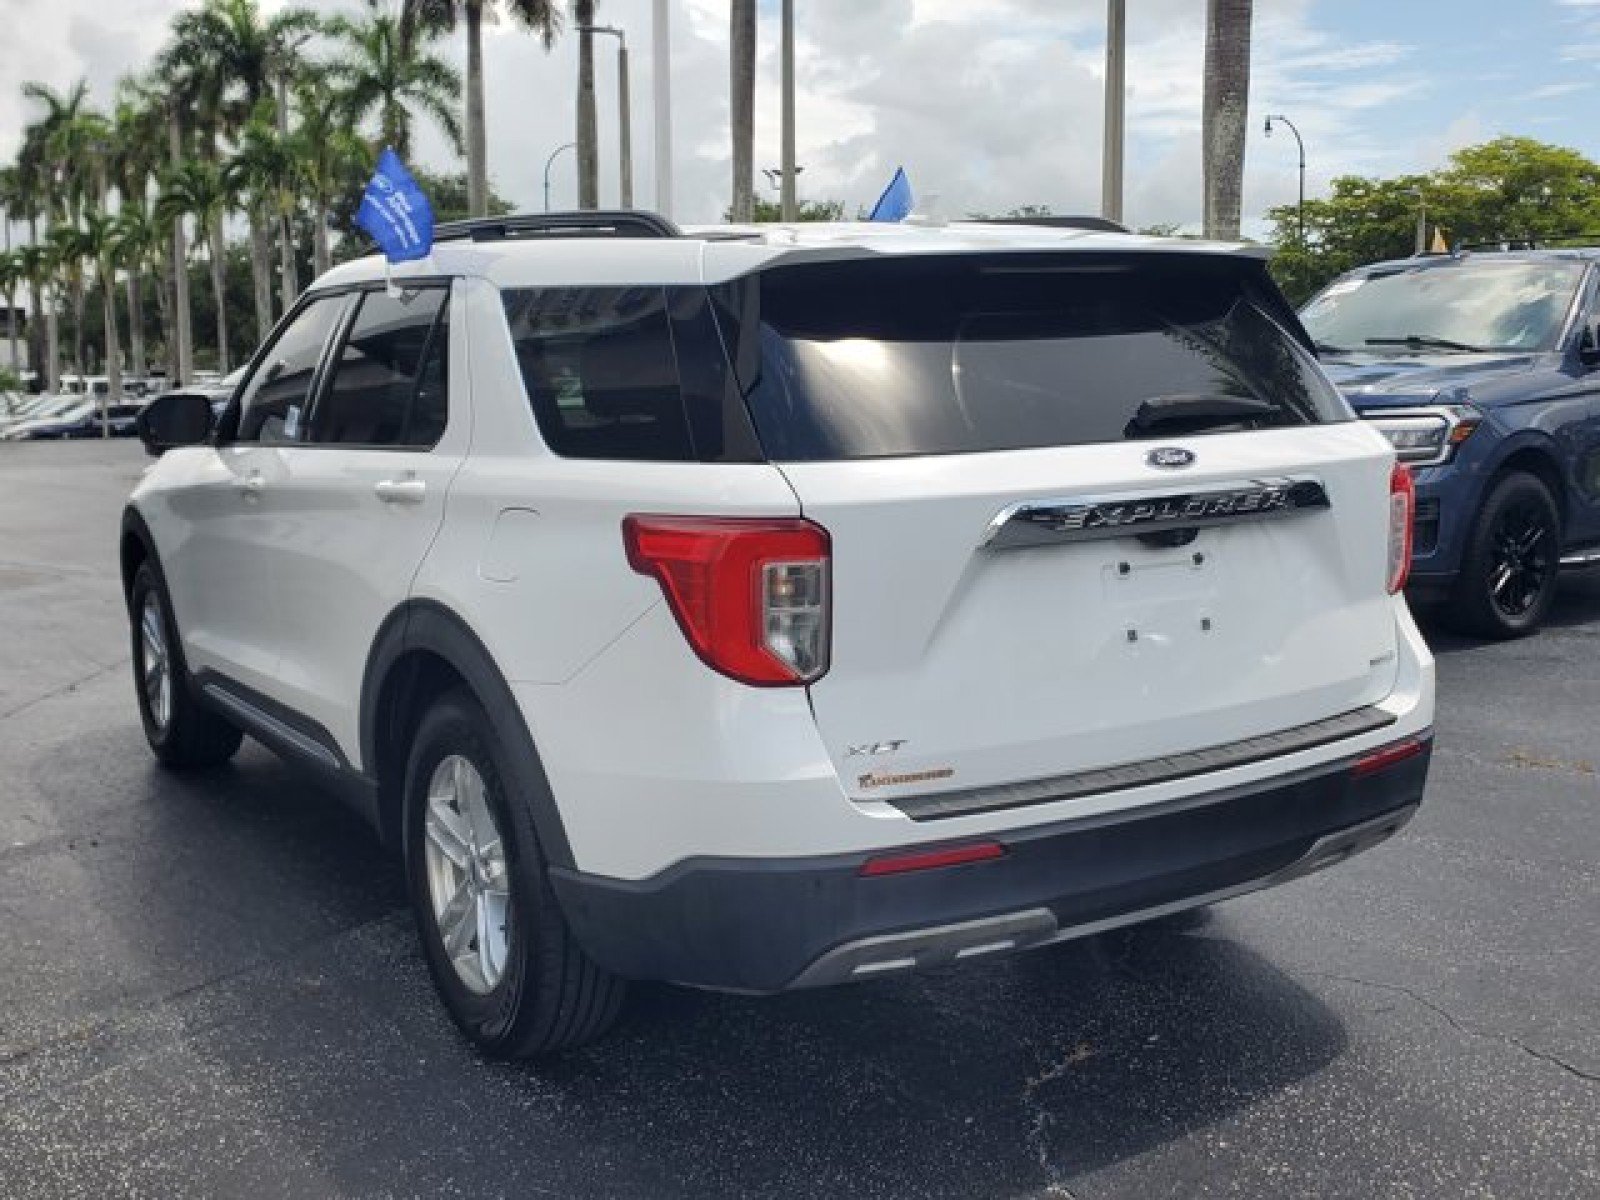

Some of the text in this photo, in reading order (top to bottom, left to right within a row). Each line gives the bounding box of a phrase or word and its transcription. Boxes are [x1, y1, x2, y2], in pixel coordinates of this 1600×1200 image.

[1152, 448, 1191, 464] Ford
[1063, 486, 1287, 528] EXPLORER
[844, 739, 909, 757] XLT
